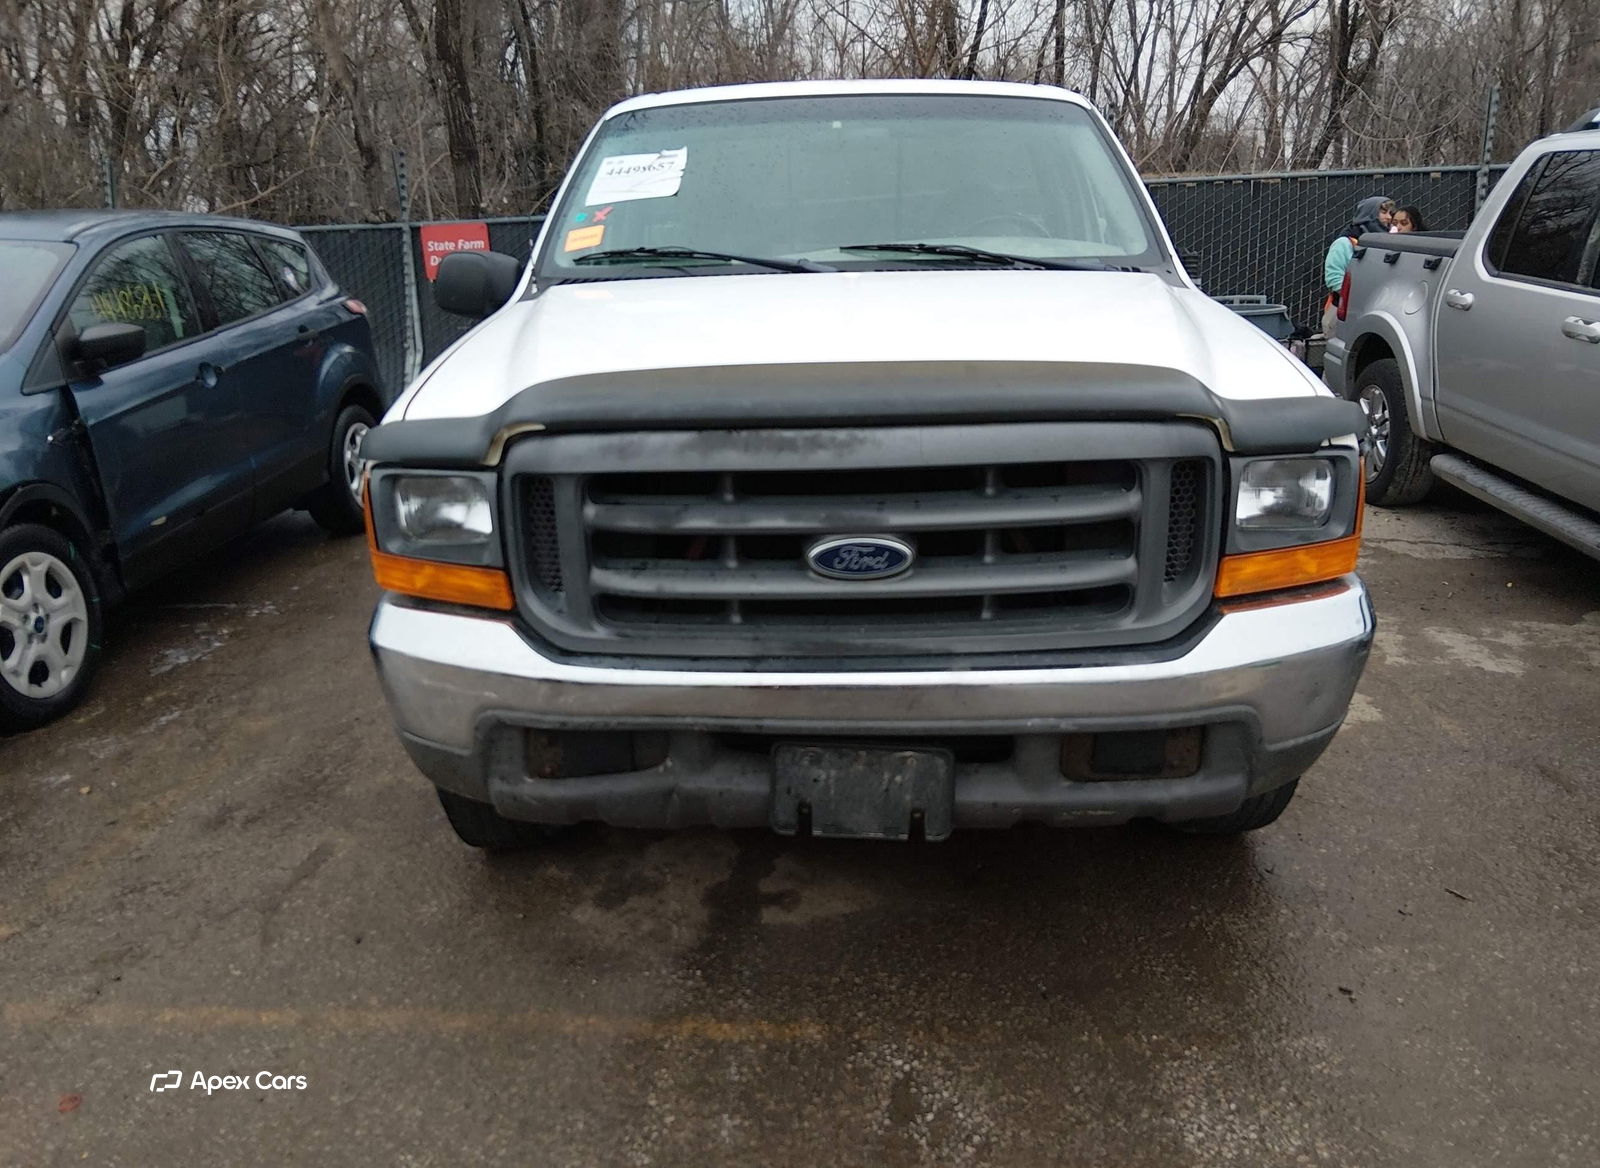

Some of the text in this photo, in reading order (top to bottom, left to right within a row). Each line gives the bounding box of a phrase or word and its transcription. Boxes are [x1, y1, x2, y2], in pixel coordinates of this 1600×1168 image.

[427, 239, 485, 252] State Farm
[833, 545, 890, 570] Ford
